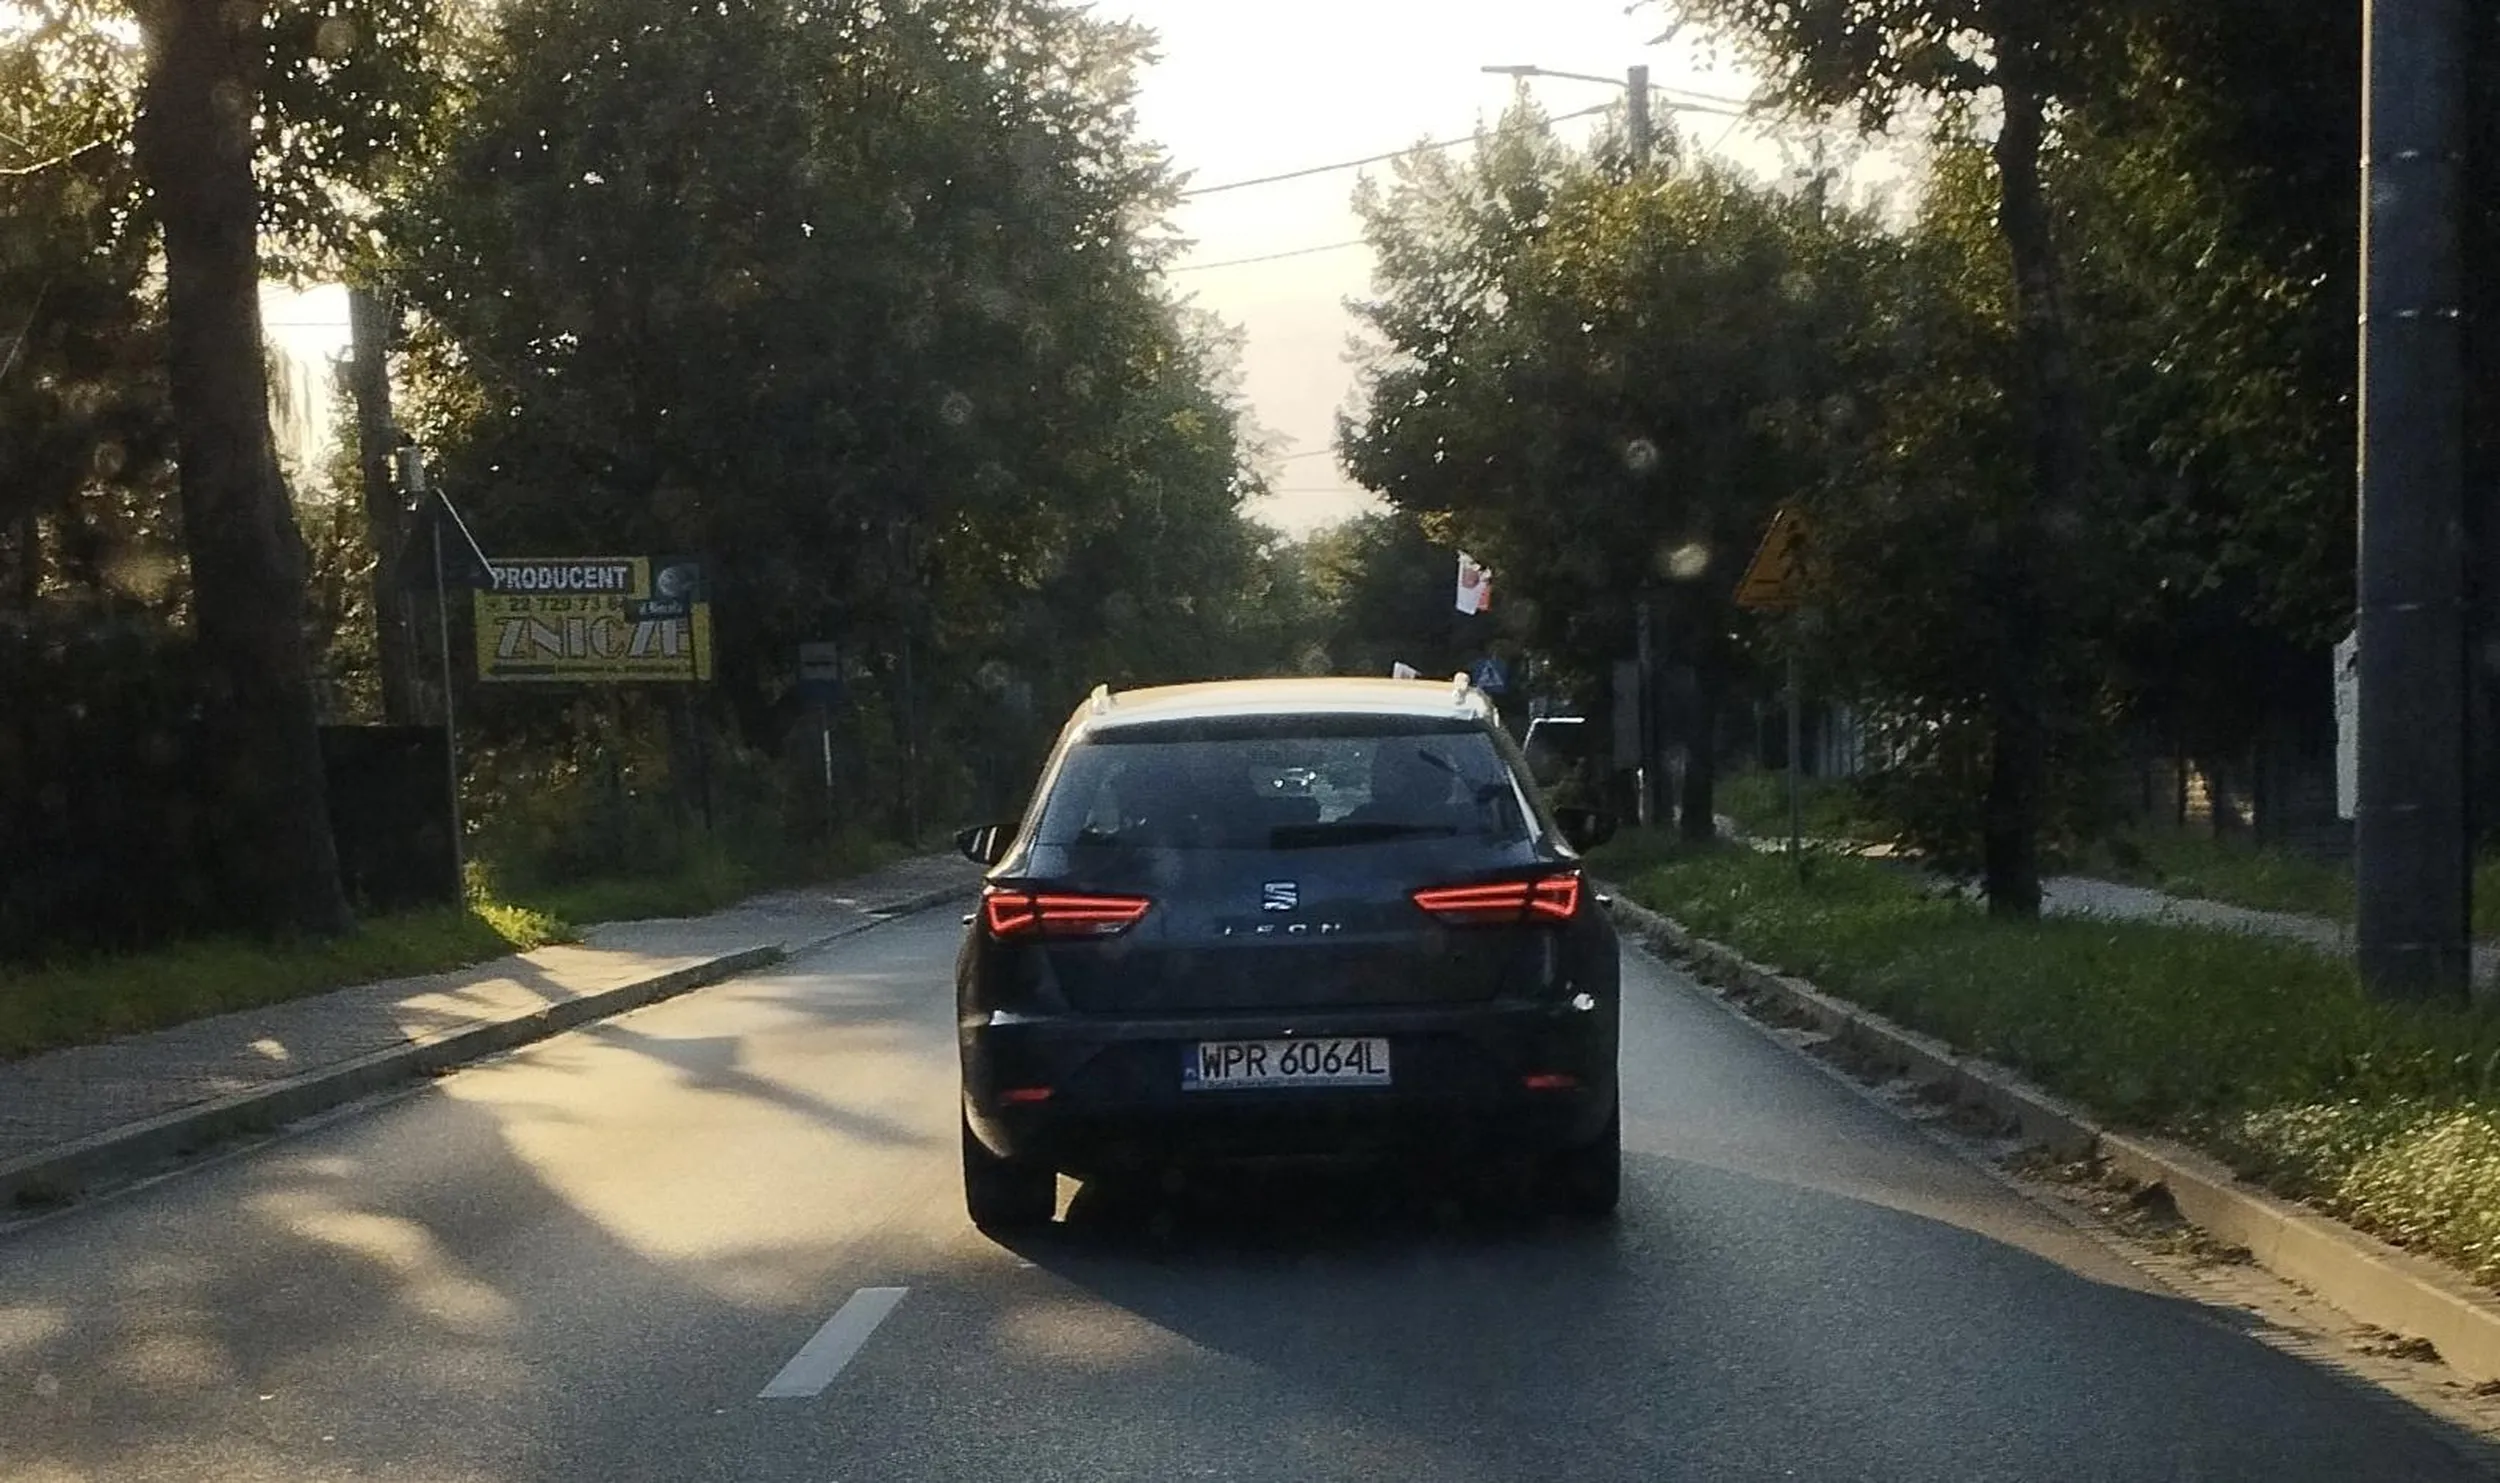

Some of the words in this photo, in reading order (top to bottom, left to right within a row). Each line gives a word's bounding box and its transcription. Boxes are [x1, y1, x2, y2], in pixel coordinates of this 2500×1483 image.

[493, 566, 628, 590] PRODUCENT
[494, 615, 691, 660] ZNICZE
[1201, 1044, 1268, 1079] WPR
[1279, 1040, 1386, 1076] 6064L
